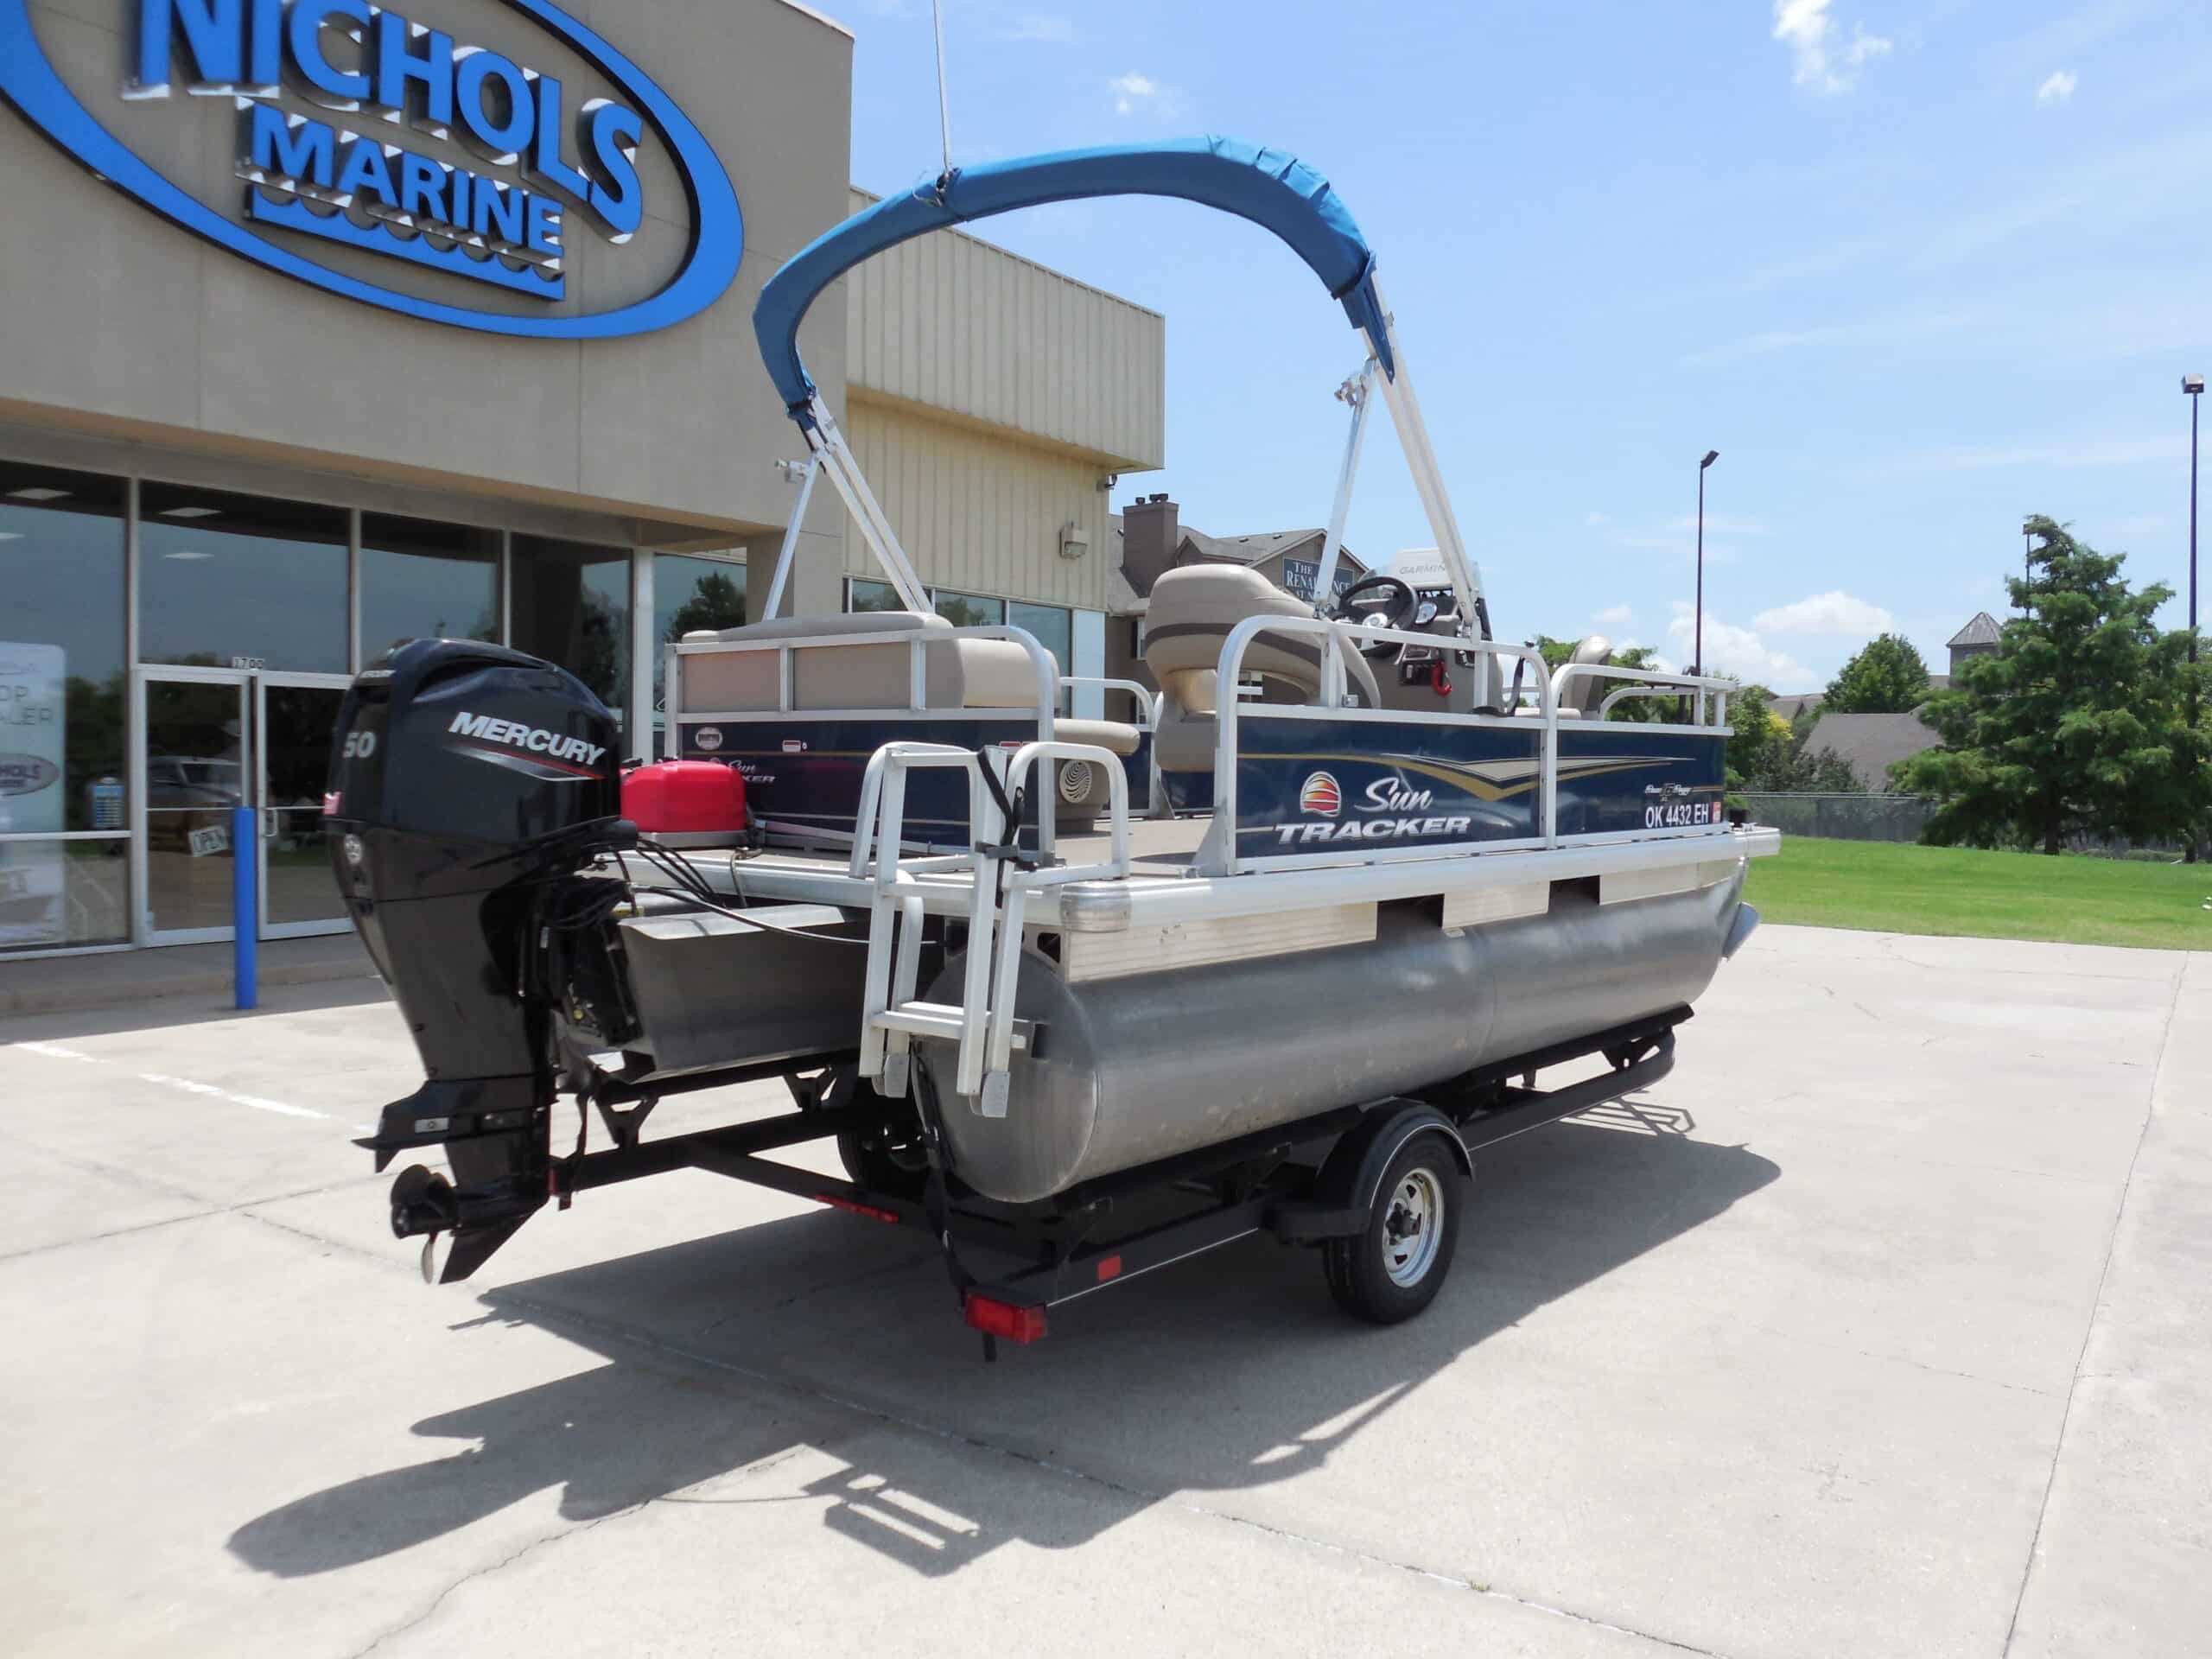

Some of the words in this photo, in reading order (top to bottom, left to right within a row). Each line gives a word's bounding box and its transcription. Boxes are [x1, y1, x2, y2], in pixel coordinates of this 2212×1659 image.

[137, 0, 644, 236] NICHOLS
[251, 100, 566, 258] MARINE
[1295, 562, 1313, 575] THE
[343, 732, 377, 759] 50
[448, 711, 607, 766] MERCURY
[1354, 777, 1433, 812] Sun
[1274, 817, 1471, 845] TRACKER
[1645, 805, 1663, 829] OK
[1666, 804, 1692, 826] 4432
[1694, 803, 1709, 824] EH
